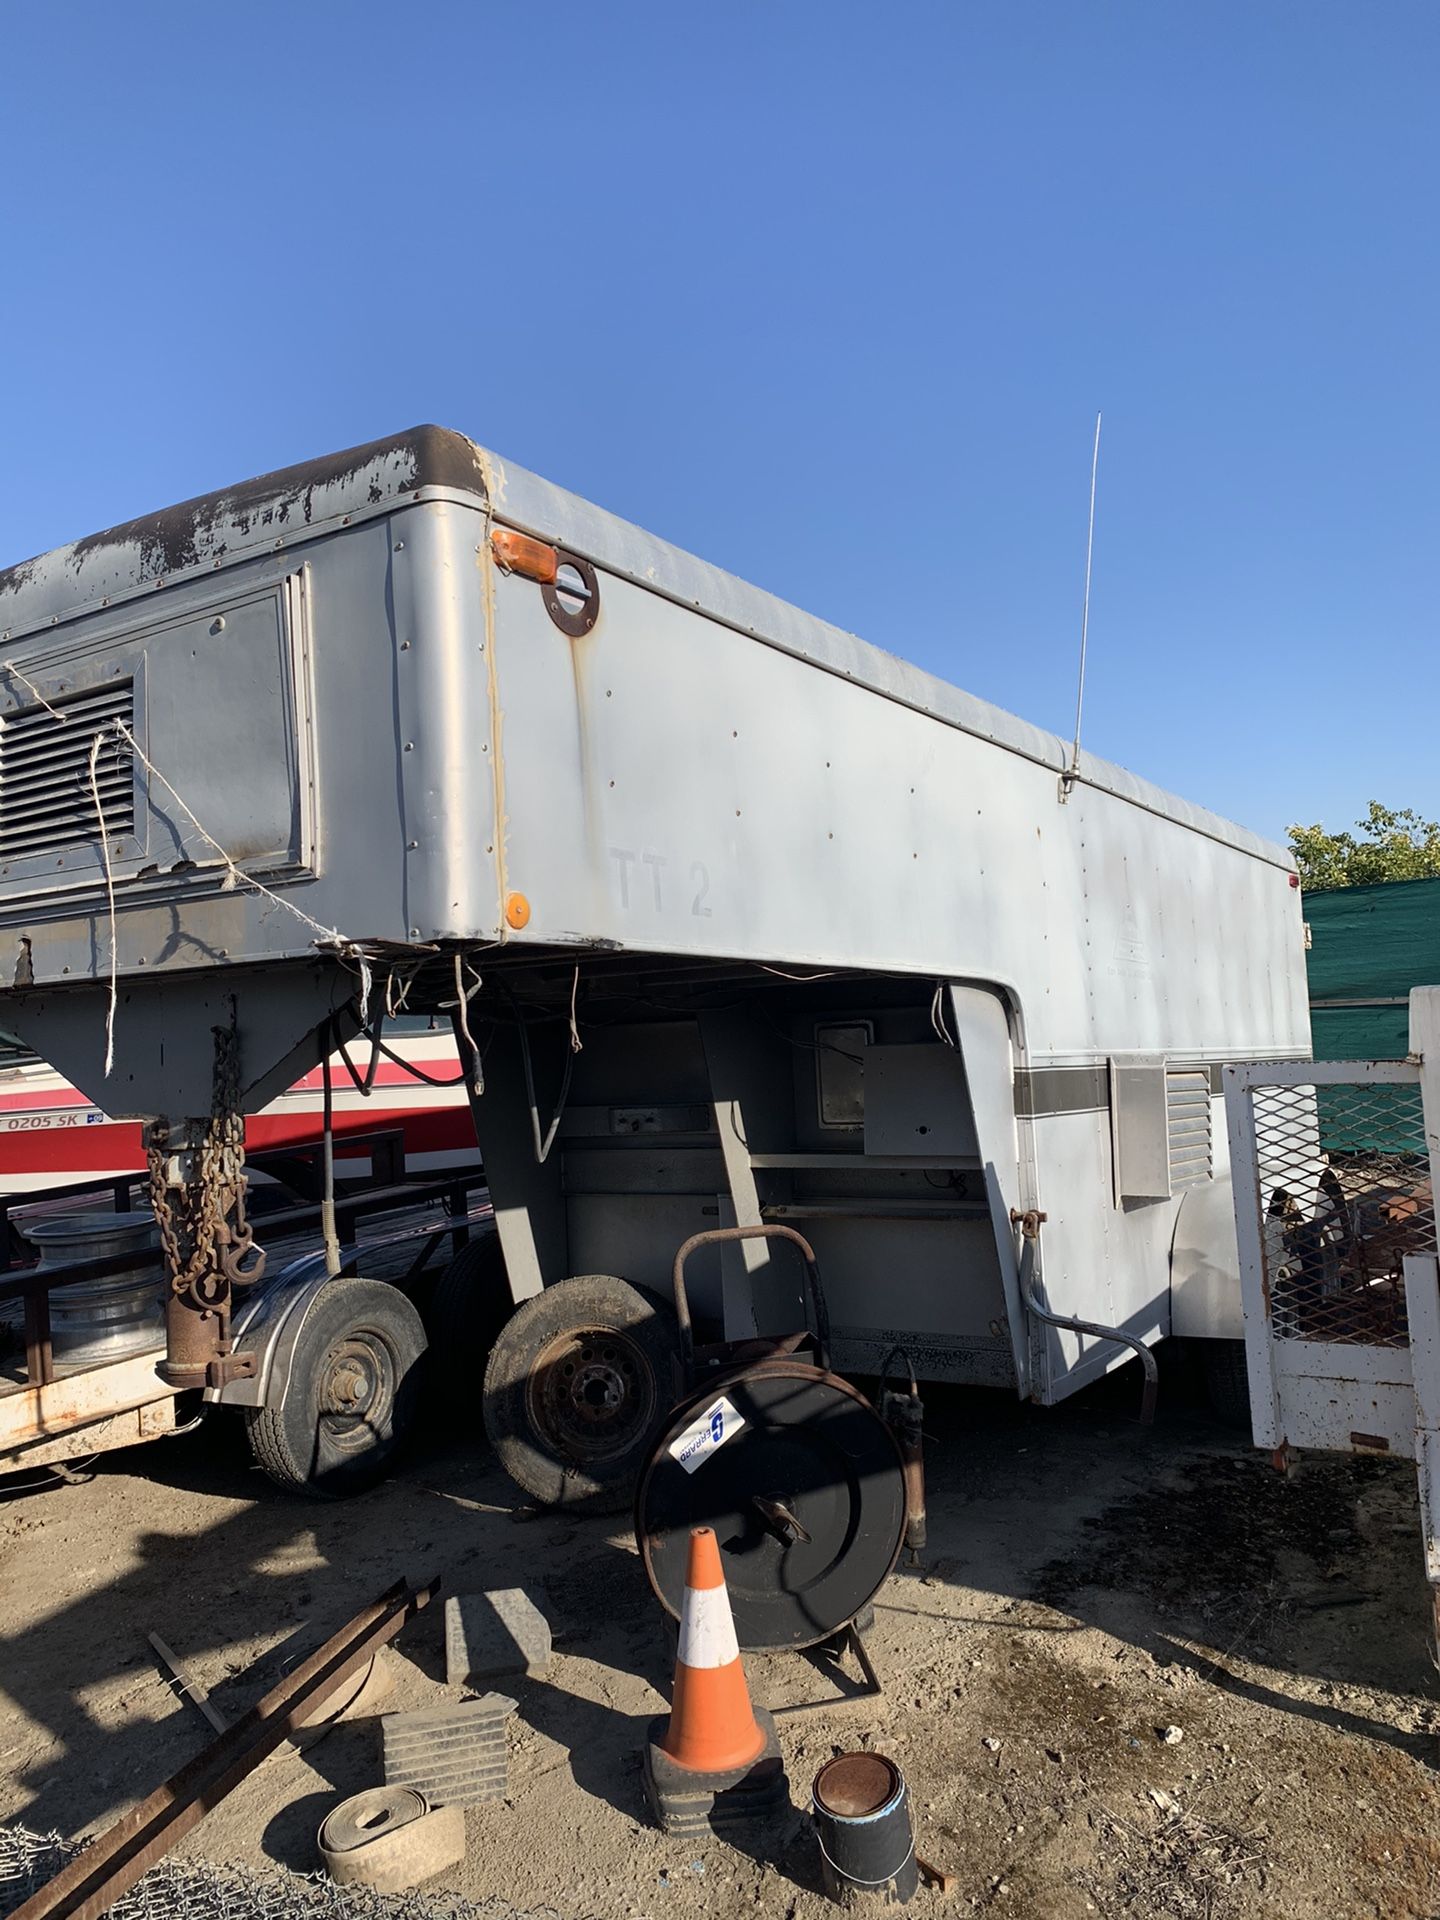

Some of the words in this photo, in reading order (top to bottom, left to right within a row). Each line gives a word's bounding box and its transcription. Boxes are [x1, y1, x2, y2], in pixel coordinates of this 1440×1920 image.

[608, 847, 668, 912] TT
[689, 860, 712, 917] 2
[8, 1116, 51, 1129] 0205
[57, 1115, 78, 1126] SK
[680, 1411, 724, 1462] GERRARD
